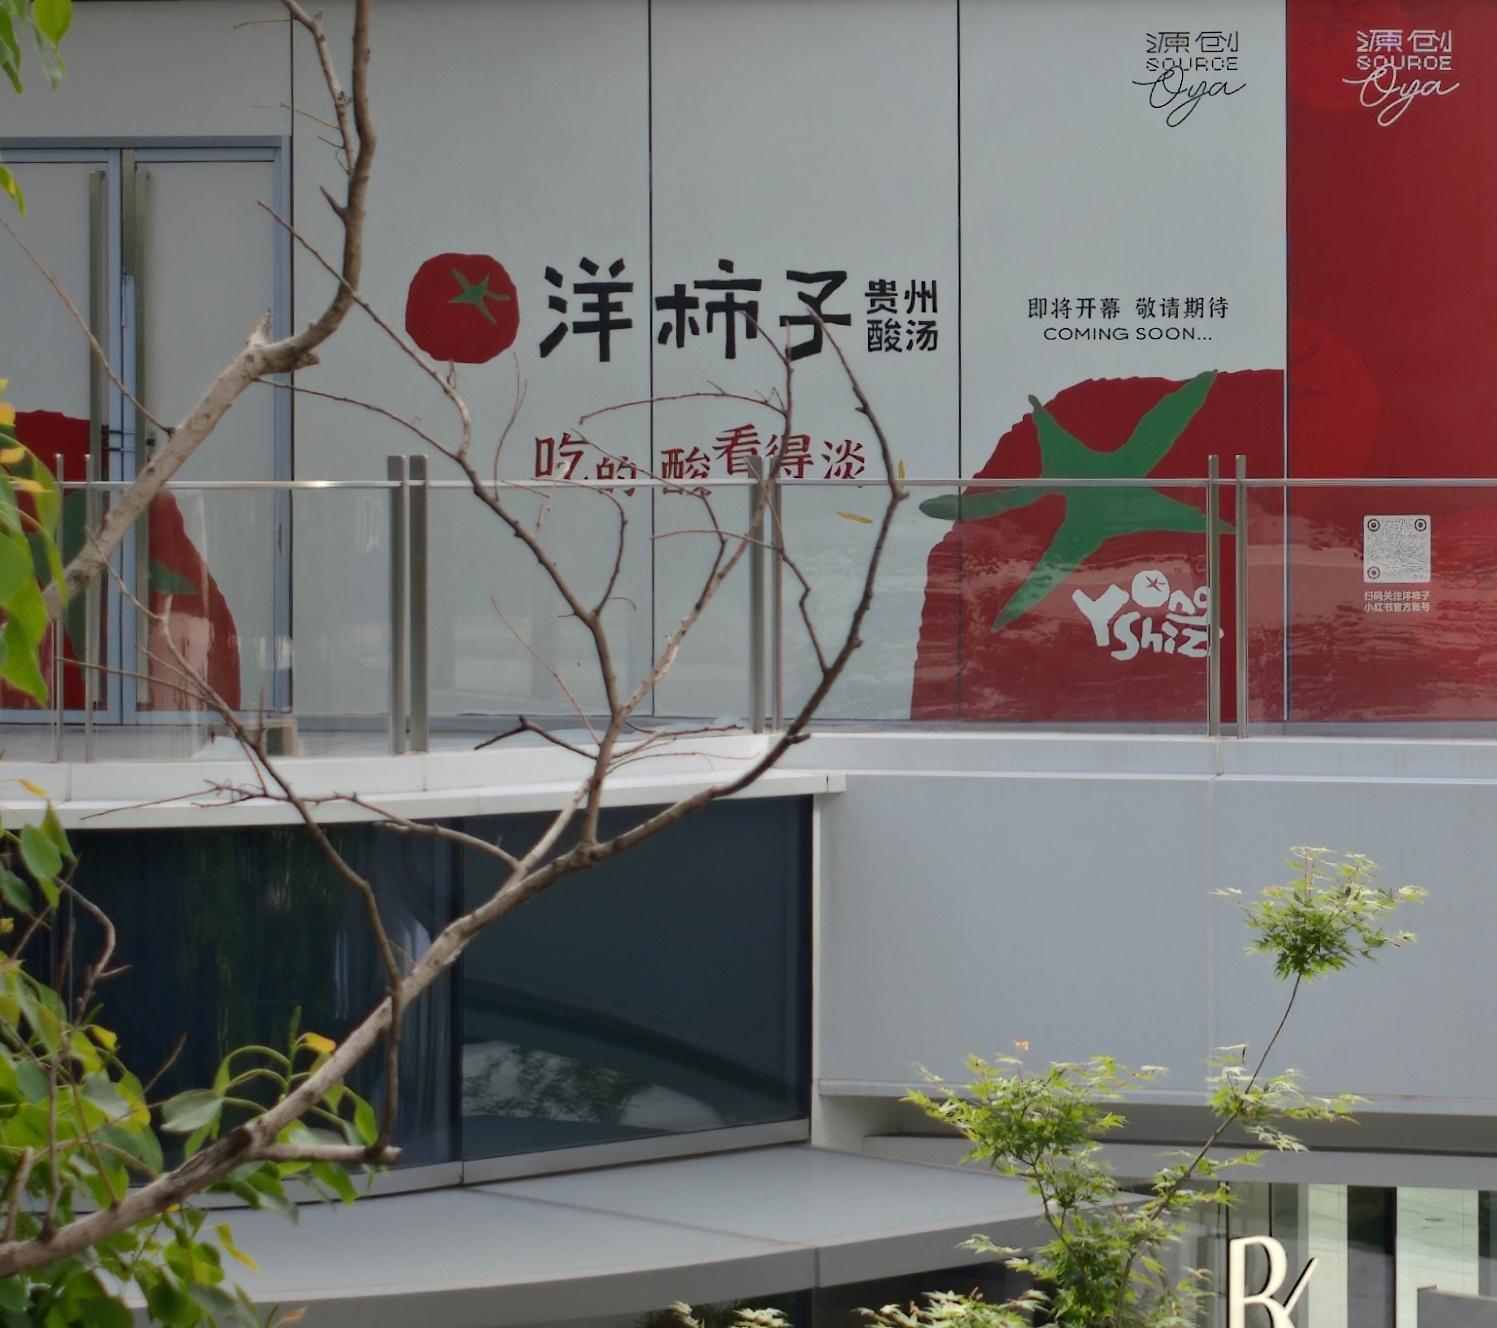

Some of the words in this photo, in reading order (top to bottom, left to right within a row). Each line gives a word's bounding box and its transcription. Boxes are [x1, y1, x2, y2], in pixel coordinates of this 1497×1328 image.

[1145, 56, 1240, 72] SOURCE
[1356, 54, 1453, 71] SOURCE
[864, 278, 938, 315] 贵州
[1027, 296, 1121, 320] 即将开幕
[1134, 295, 1230, 320] 敬请期待
[538, 256, 853, 363] 洋柿子
[866, 317, 939, 353] 酸汤
[1043, 327, 1129, 341] COMING
[1135, 327, 1213, 341] SOON...
